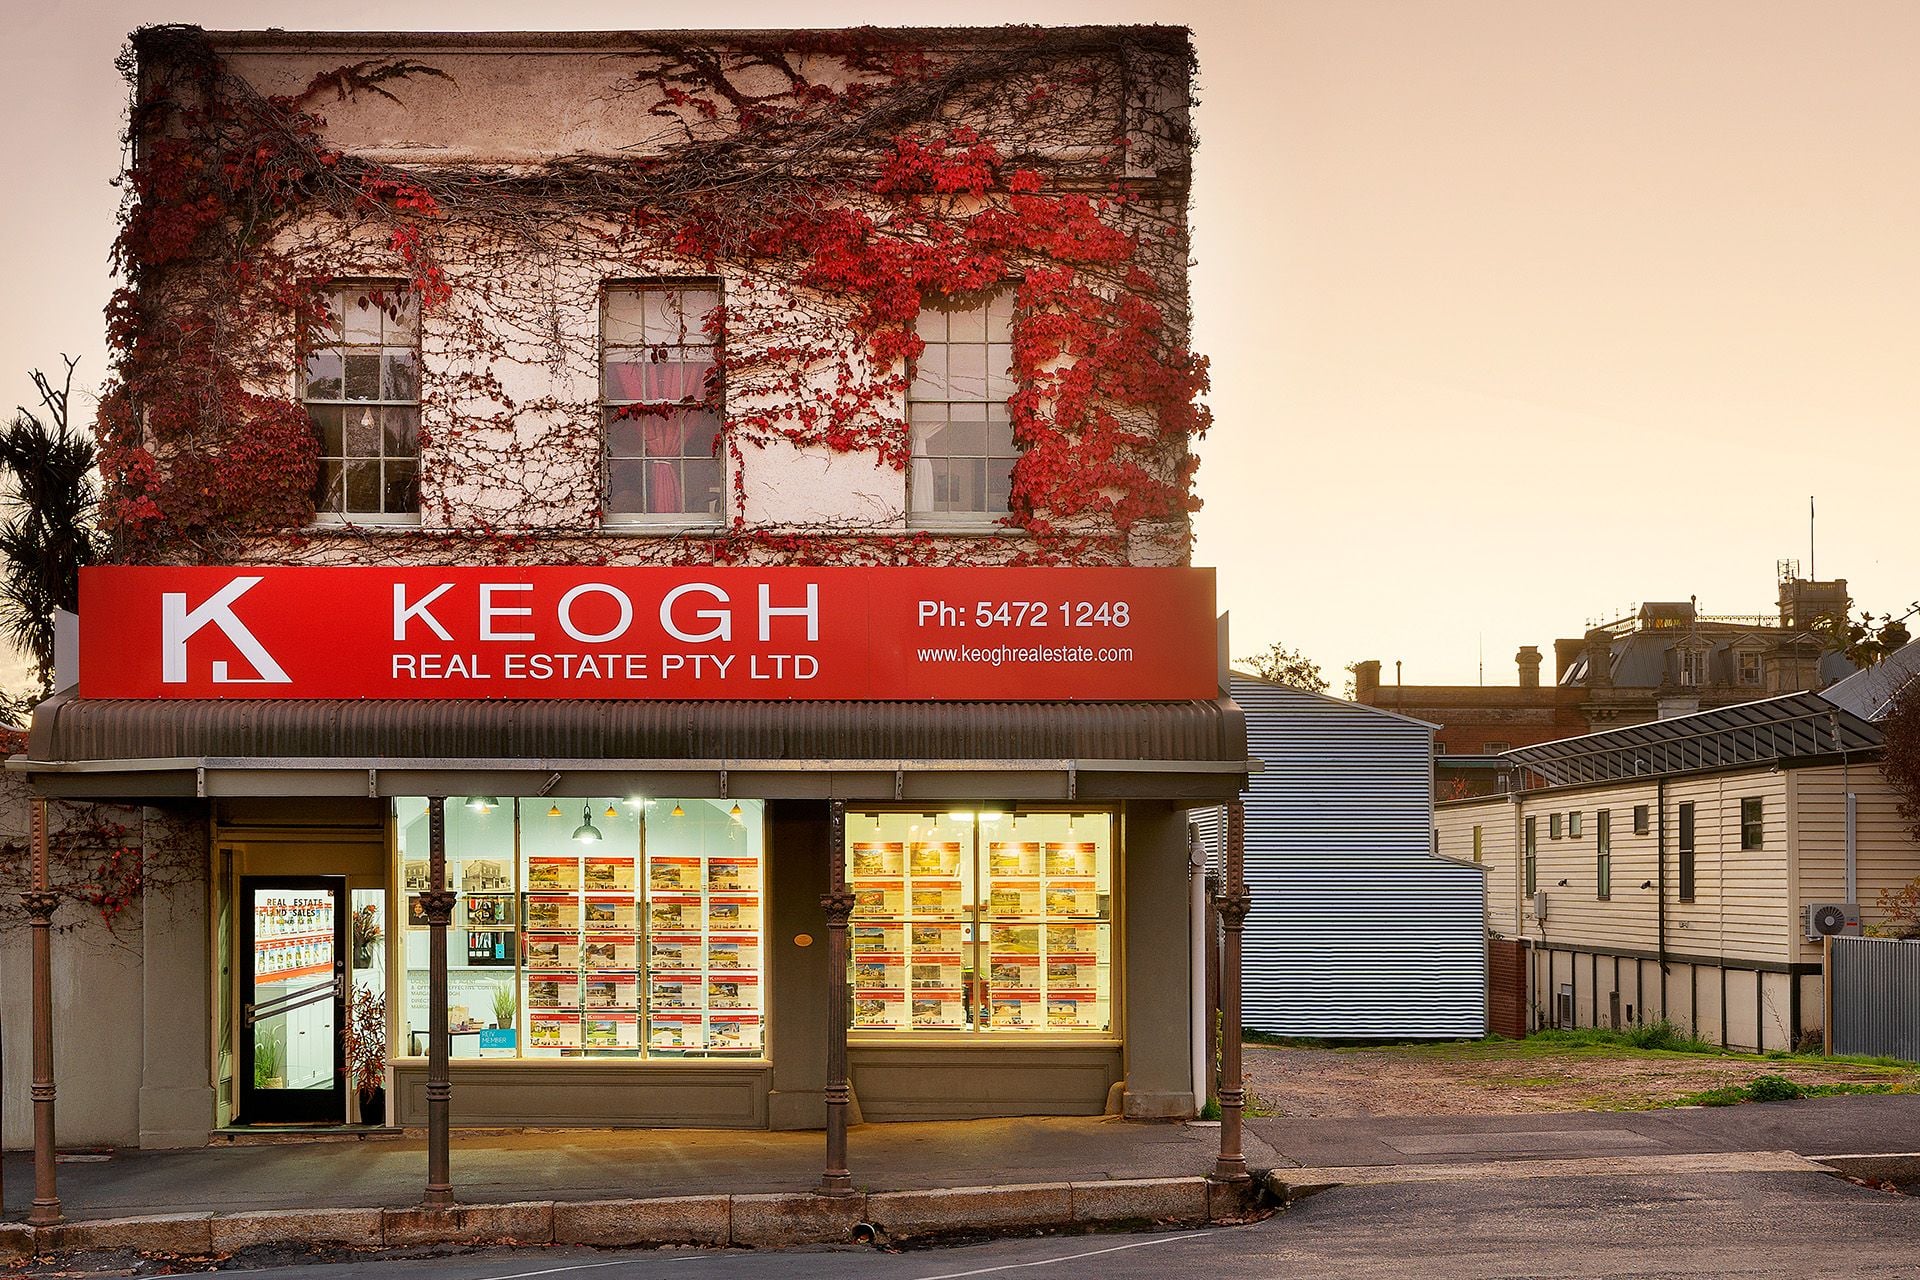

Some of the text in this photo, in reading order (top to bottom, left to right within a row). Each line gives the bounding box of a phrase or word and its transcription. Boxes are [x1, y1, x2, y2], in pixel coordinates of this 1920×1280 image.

[393, 583, 819, 643] KEOGH
[918, 600, 1130, 628] Ph: 5472 1248
[162, 576, 292, 683] K
[392, 654, 819, 680] REAL ESTATE PTY LTD
[917, 644, 1133, 667] www.keoghrealestate.com
[266, 898, 323, 907] REAL ESTATE
[266, 909, 287, 917] LAND
[292, 909, 316, 917] SALES
